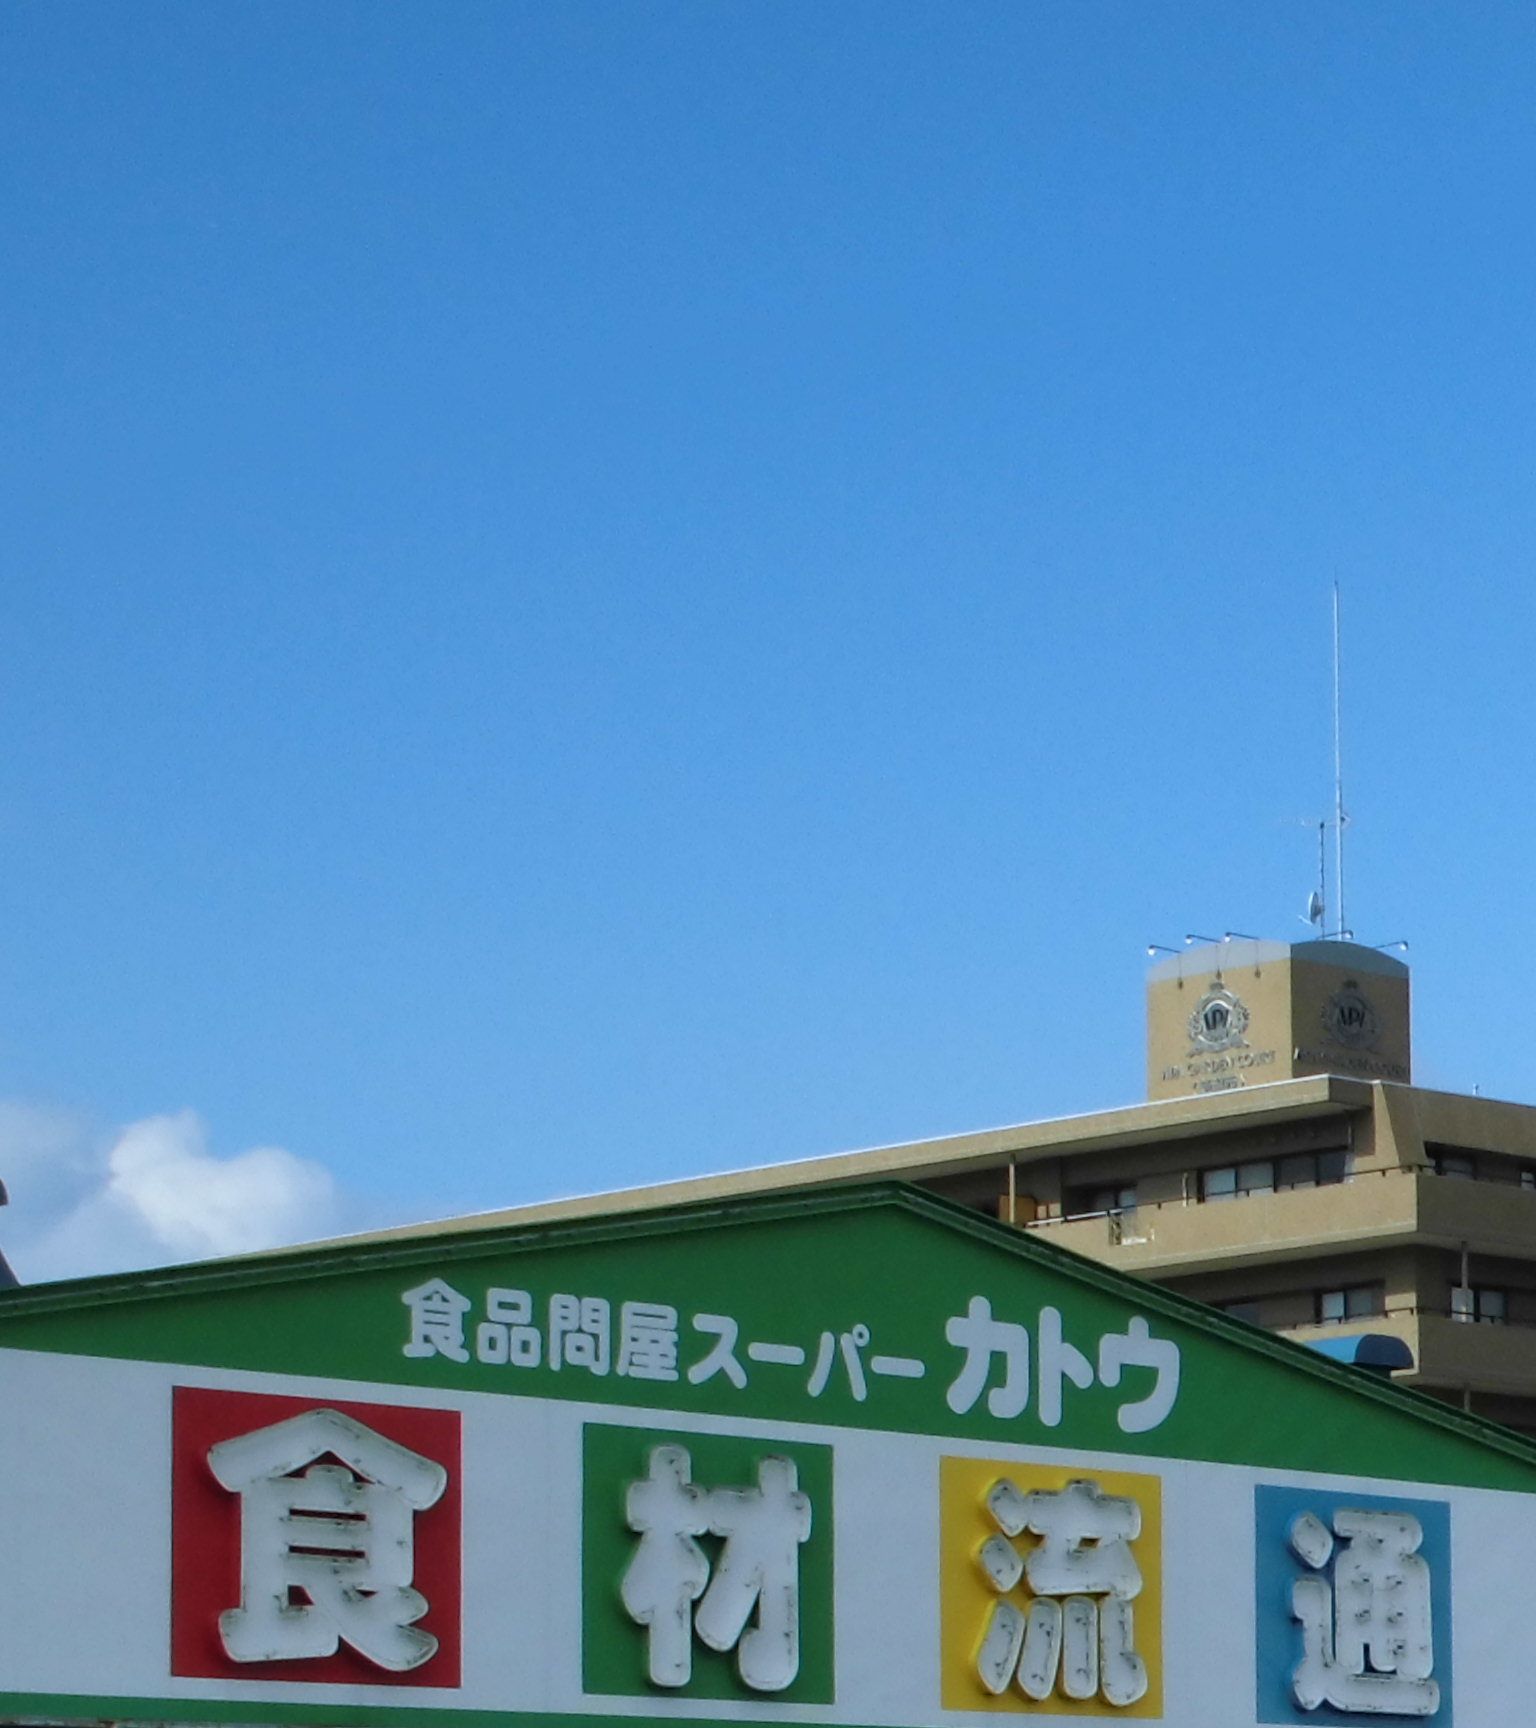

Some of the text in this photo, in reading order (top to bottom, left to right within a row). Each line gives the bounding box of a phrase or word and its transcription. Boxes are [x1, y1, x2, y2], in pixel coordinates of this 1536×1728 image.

[401, 1277, 1181, 1434] 食品問屋スーパー カトウ
[206, 1407, 1441, 1717] 食材流通
